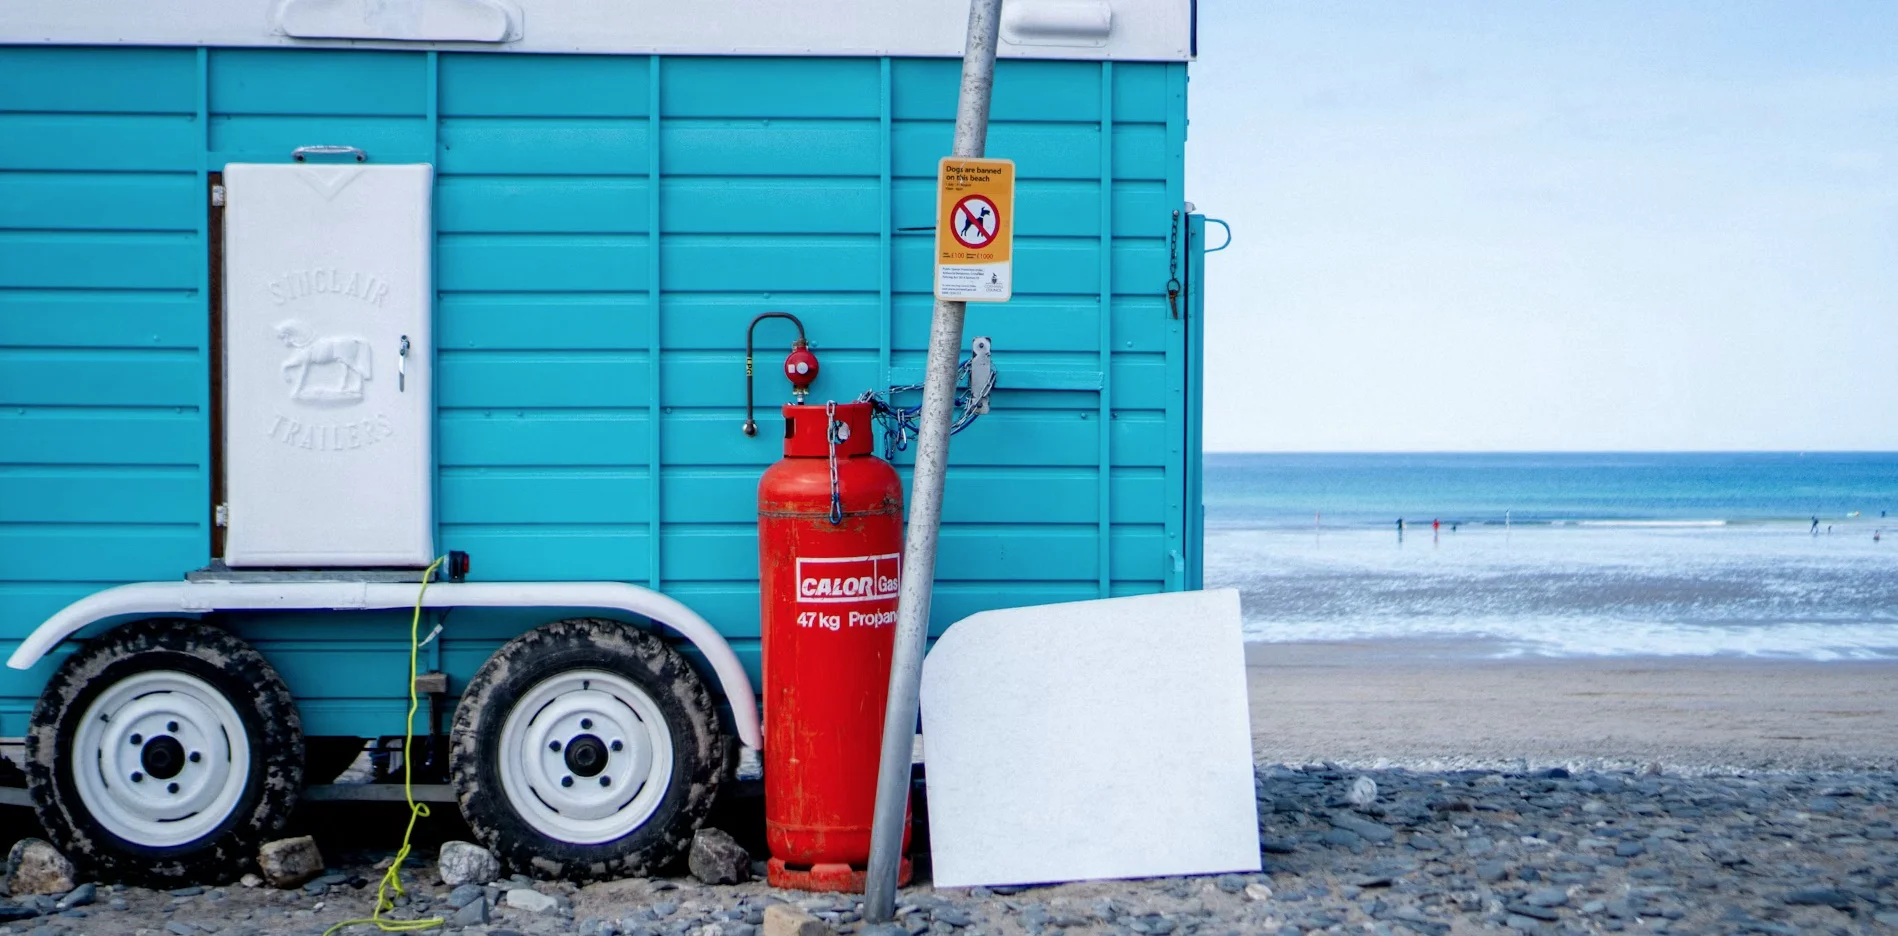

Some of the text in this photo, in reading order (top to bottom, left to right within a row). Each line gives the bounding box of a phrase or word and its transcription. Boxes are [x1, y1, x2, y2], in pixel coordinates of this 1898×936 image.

[946, 166, 963, 174] Dogs
[269, 267, 389, 308] SINCLAIR
[267, 413, 394, 452] TRAILERS
[801, 575, 898, 597] CALOR Gas
[797, 609, 899, 631] 47 kg Propan
